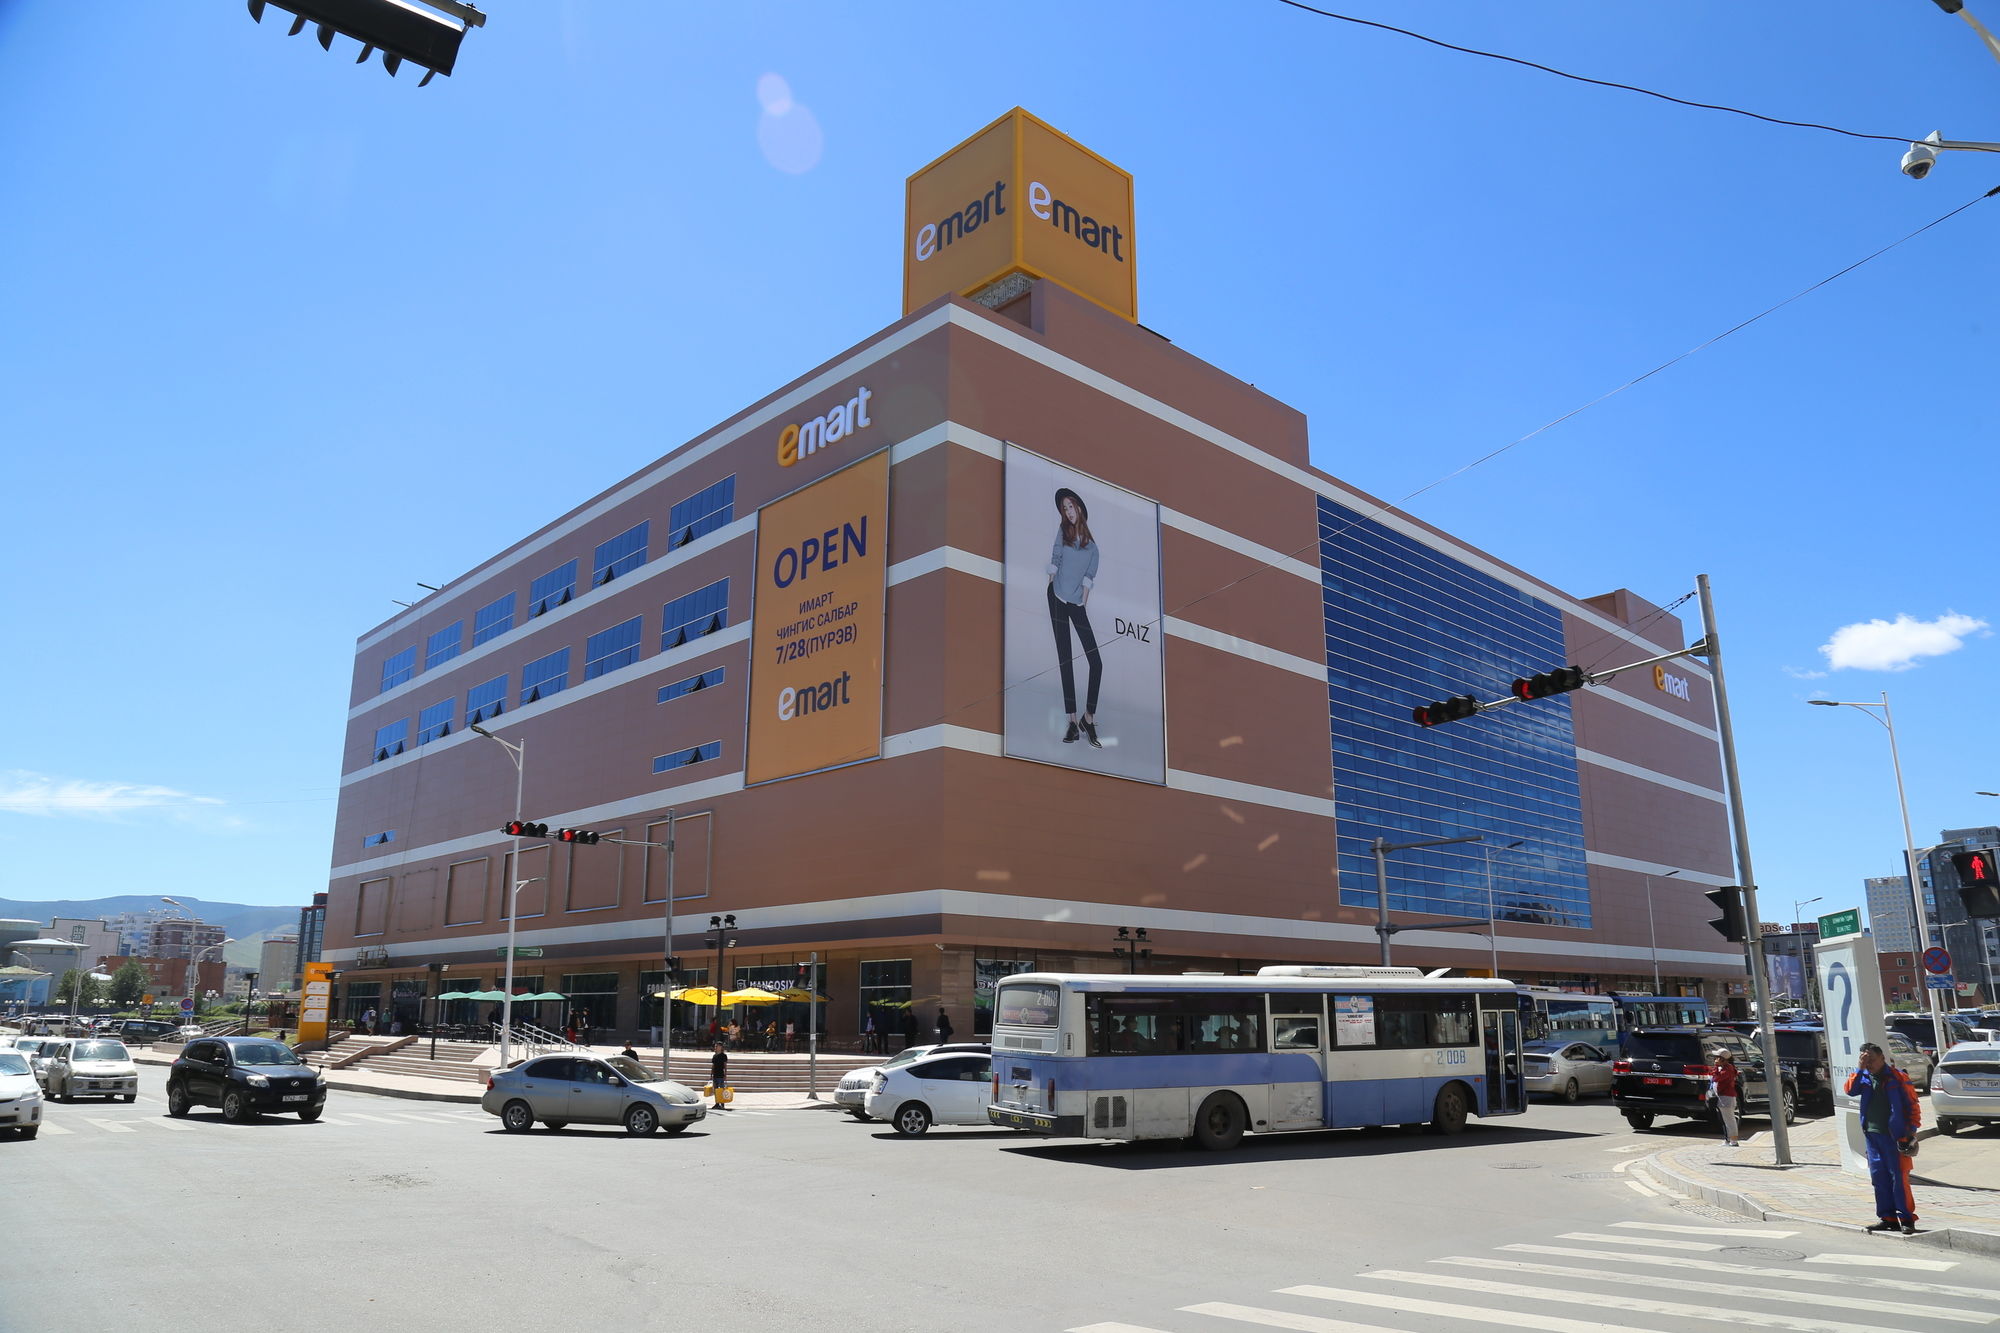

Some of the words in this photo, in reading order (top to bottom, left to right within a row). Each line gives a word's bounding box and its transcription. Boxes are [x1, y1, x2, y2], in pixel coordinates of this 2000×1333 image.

[915, 180, 1006, 262] emart
[1028, 181, 1124, 263] emart
[777, 386, 873, 468] emart
[773, 515, 868, 589] OPEN
[776, 617, 816, 640] ЧИНГИС
[817, 602, 858, 627] САЛБАР
[799, 591, 834, 615] ИМАРТ
[1115, 617, 1150, 644] DAIZ
[778, 671, 851, 722] emart
[1653, 664, 1691, 702] emart
[750, 979, 795, 991] MANGOSIX
